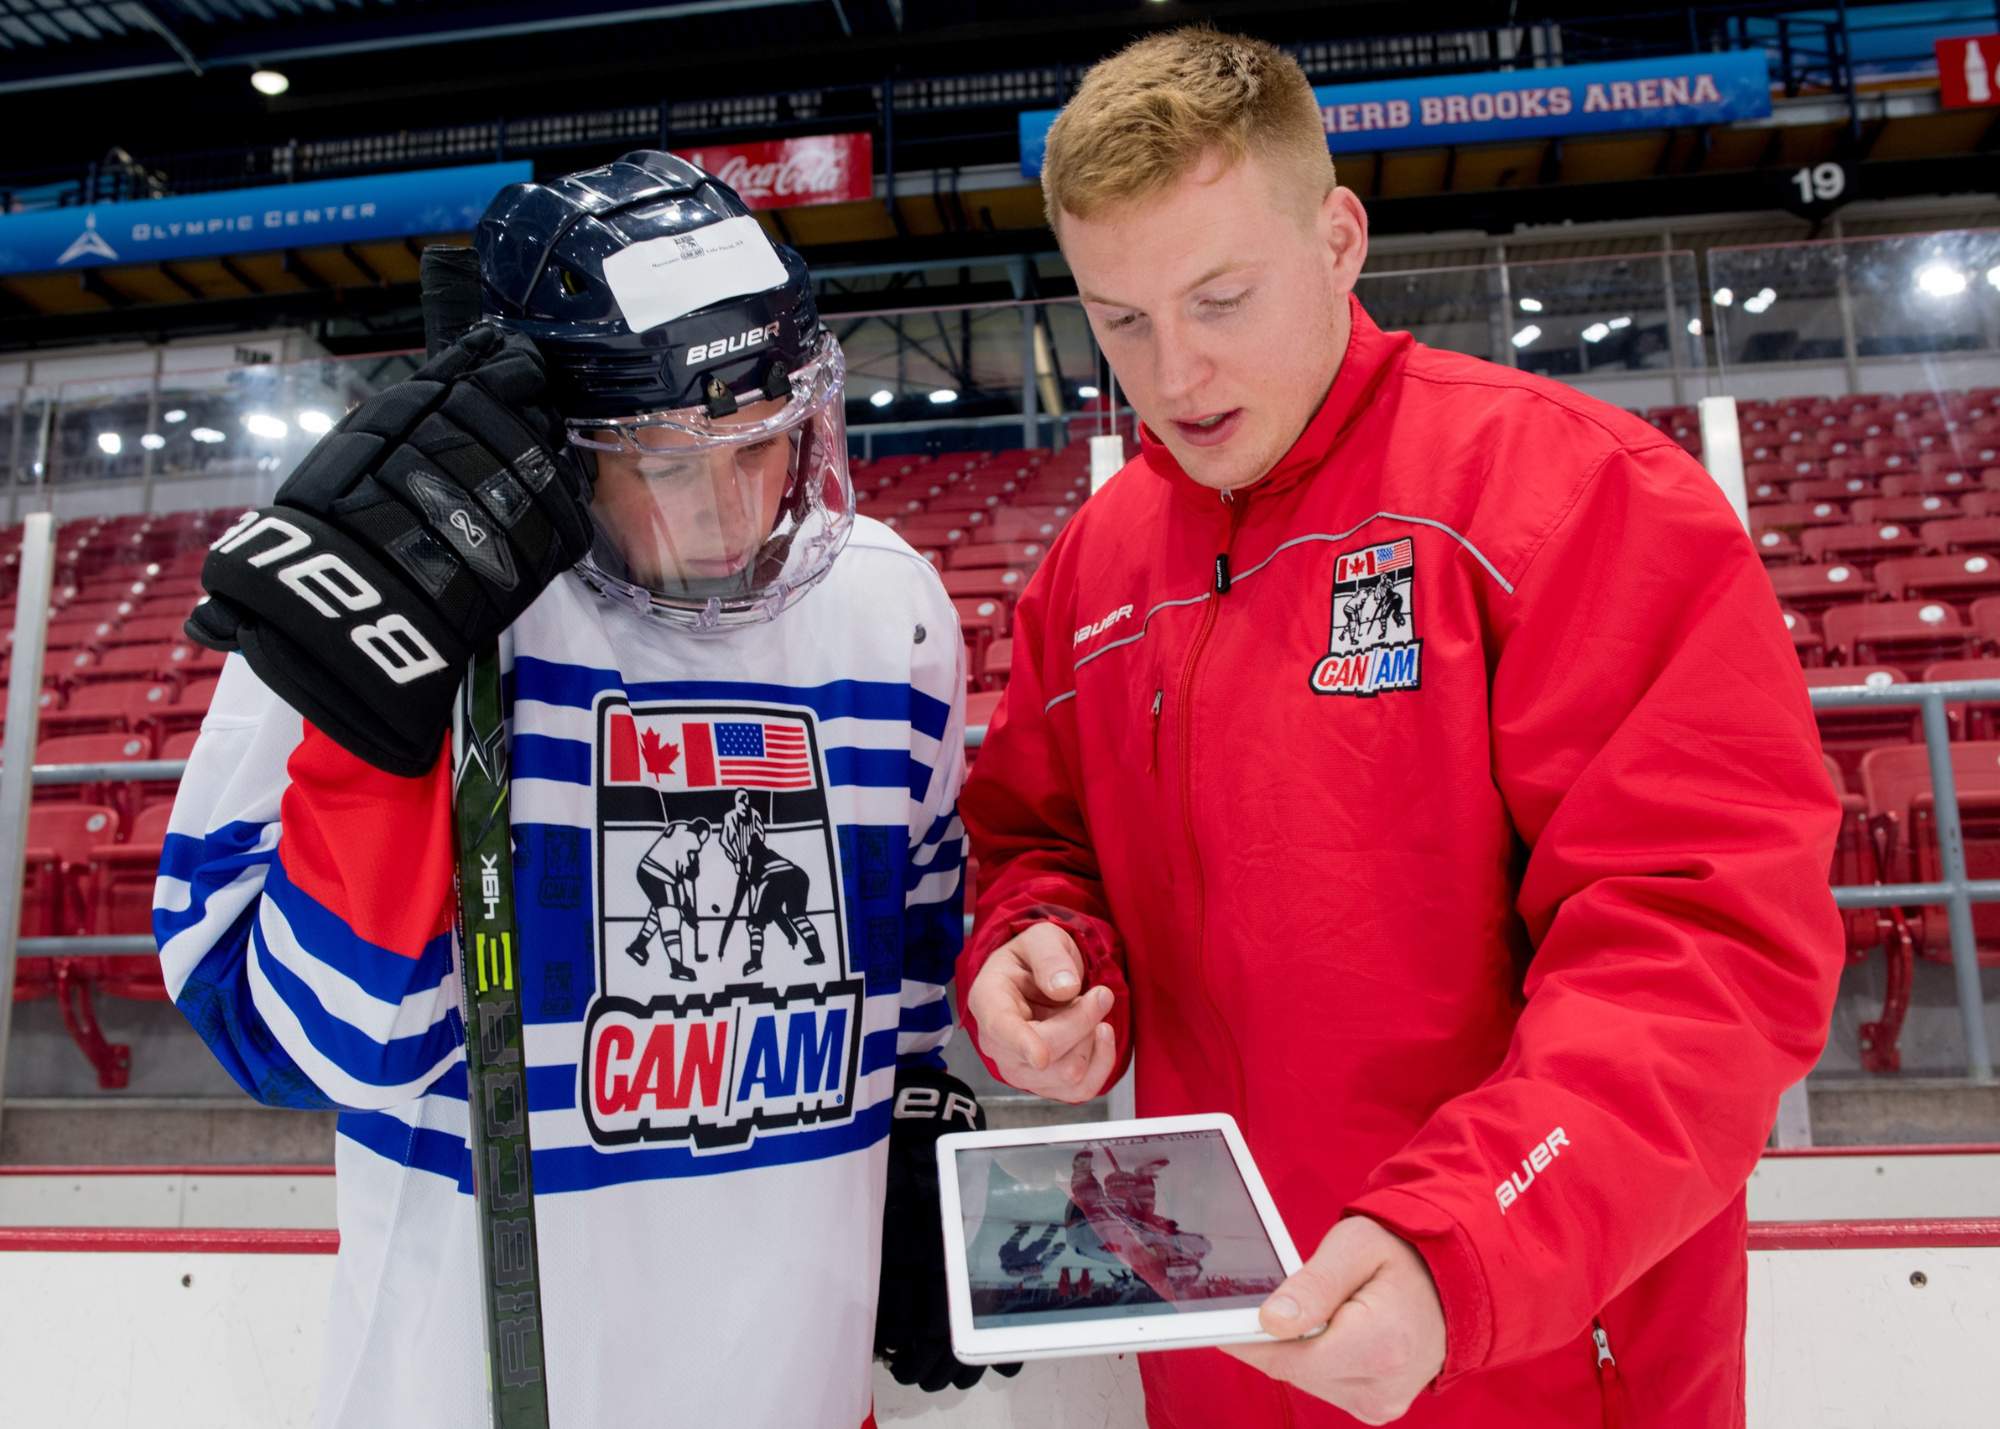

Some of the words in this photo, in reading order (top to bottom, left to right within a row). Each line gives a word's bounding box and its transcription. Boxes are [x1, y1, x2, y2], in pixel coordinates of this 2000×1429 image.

[1420, 87, 1572, 126] BROOKS
[1583, 75, 1721, 113] ARENA
[1792, 162, 1845, 204] 19
[132, 215, 253, 241] OLYMPIC
[264, 203, 376, 228] CENTER
[686, 320, 780, 366] BAUER
[1318, 655, 1370, 687] CAN
[1375, 648, 1415, 685] AM
[595, 1019, 729, 1116] CAN
[736, 1008, 847, 1103] AM
